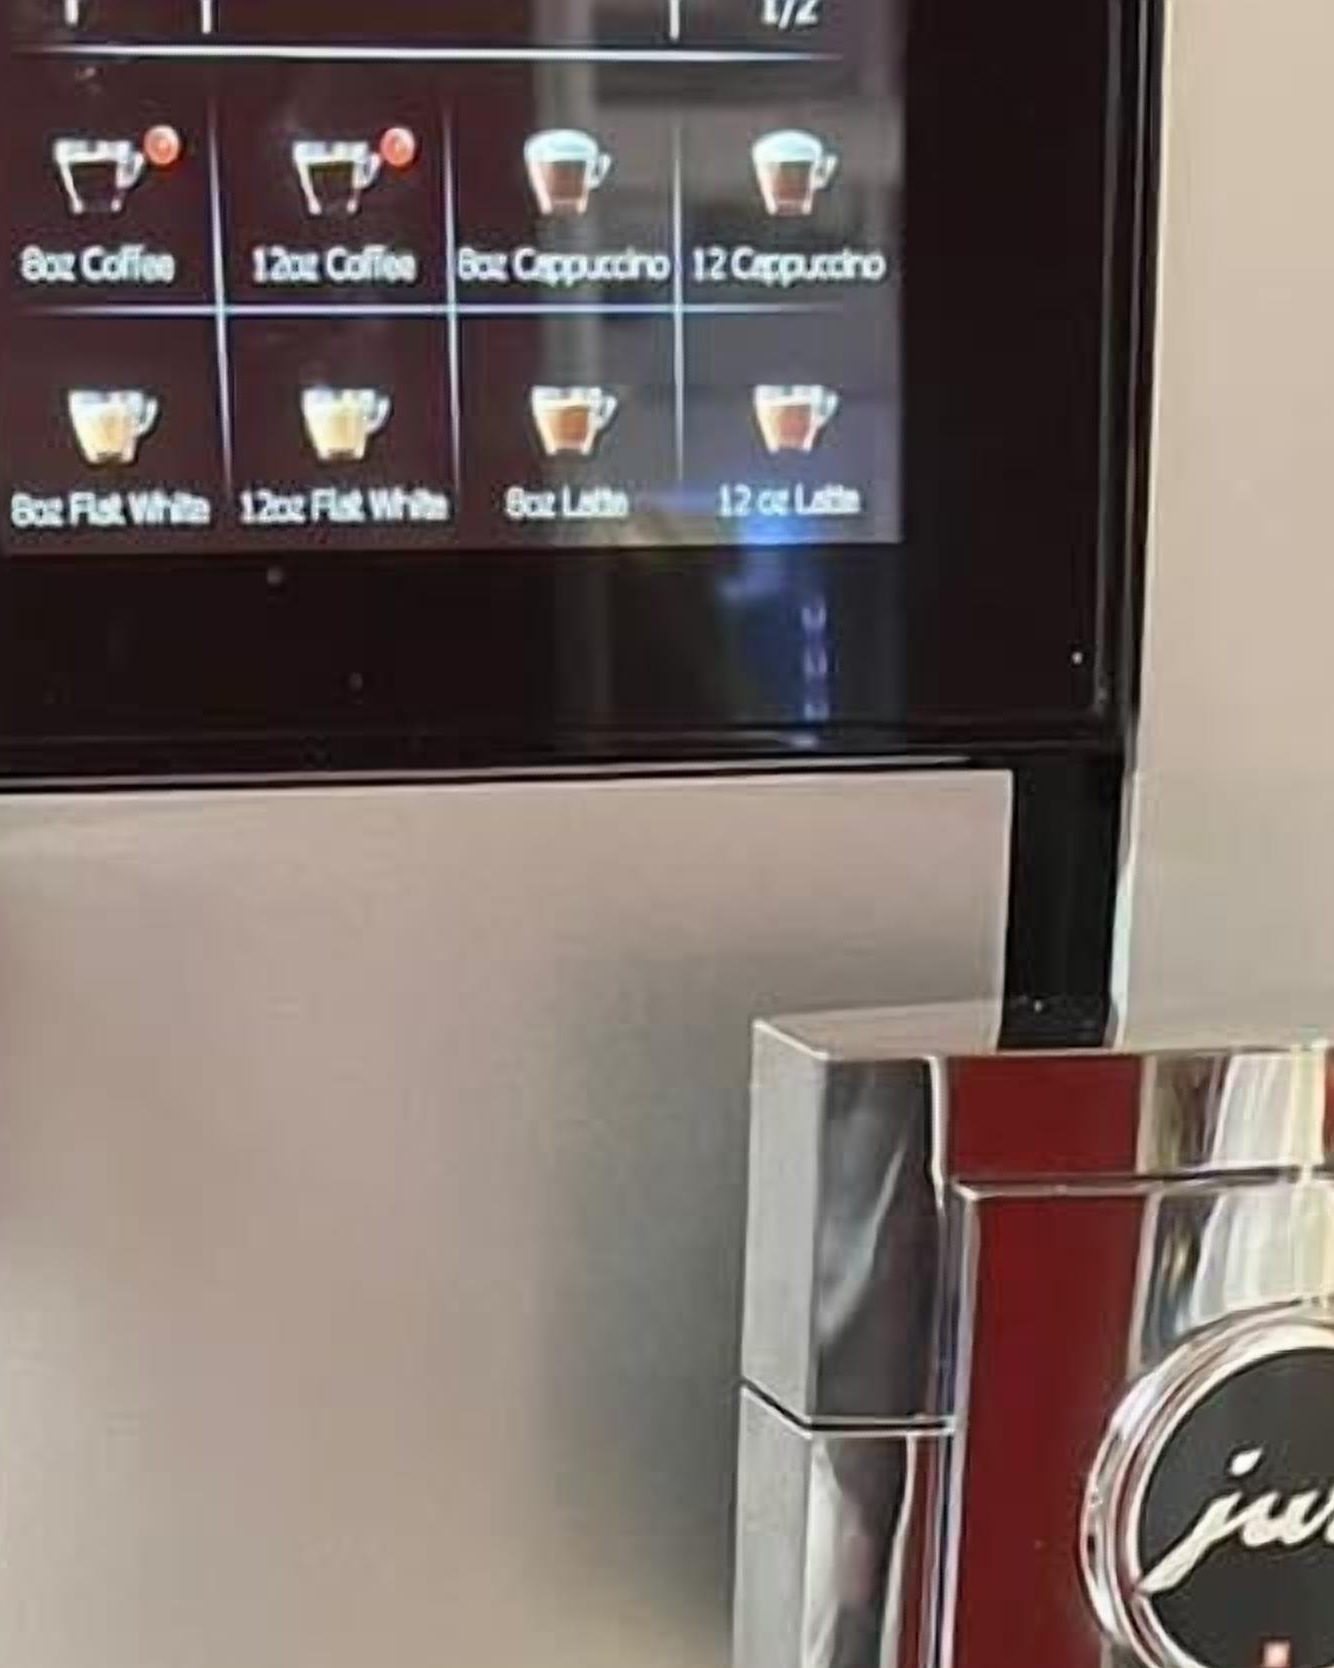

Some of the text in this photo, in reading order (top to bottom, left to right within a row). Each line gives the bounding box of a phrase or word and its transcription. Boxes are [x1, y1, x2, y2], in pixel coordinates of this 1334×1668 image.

[21, 245, 175, 282] 8oz Coffee
[253, 245, 417, 282] 12oz Coffee
[514, 247, 671, 286] Cappuccino
[693, 247, 886, 287] 12 Cappuccino
[11, 491, 211, 528] 8oz Flat White
[240, 488, 449, 525] 12oz Flat White
[506, 484, 629, 517] 8oz Latte
[719, 483, 861, 516] 12 oz Latte
